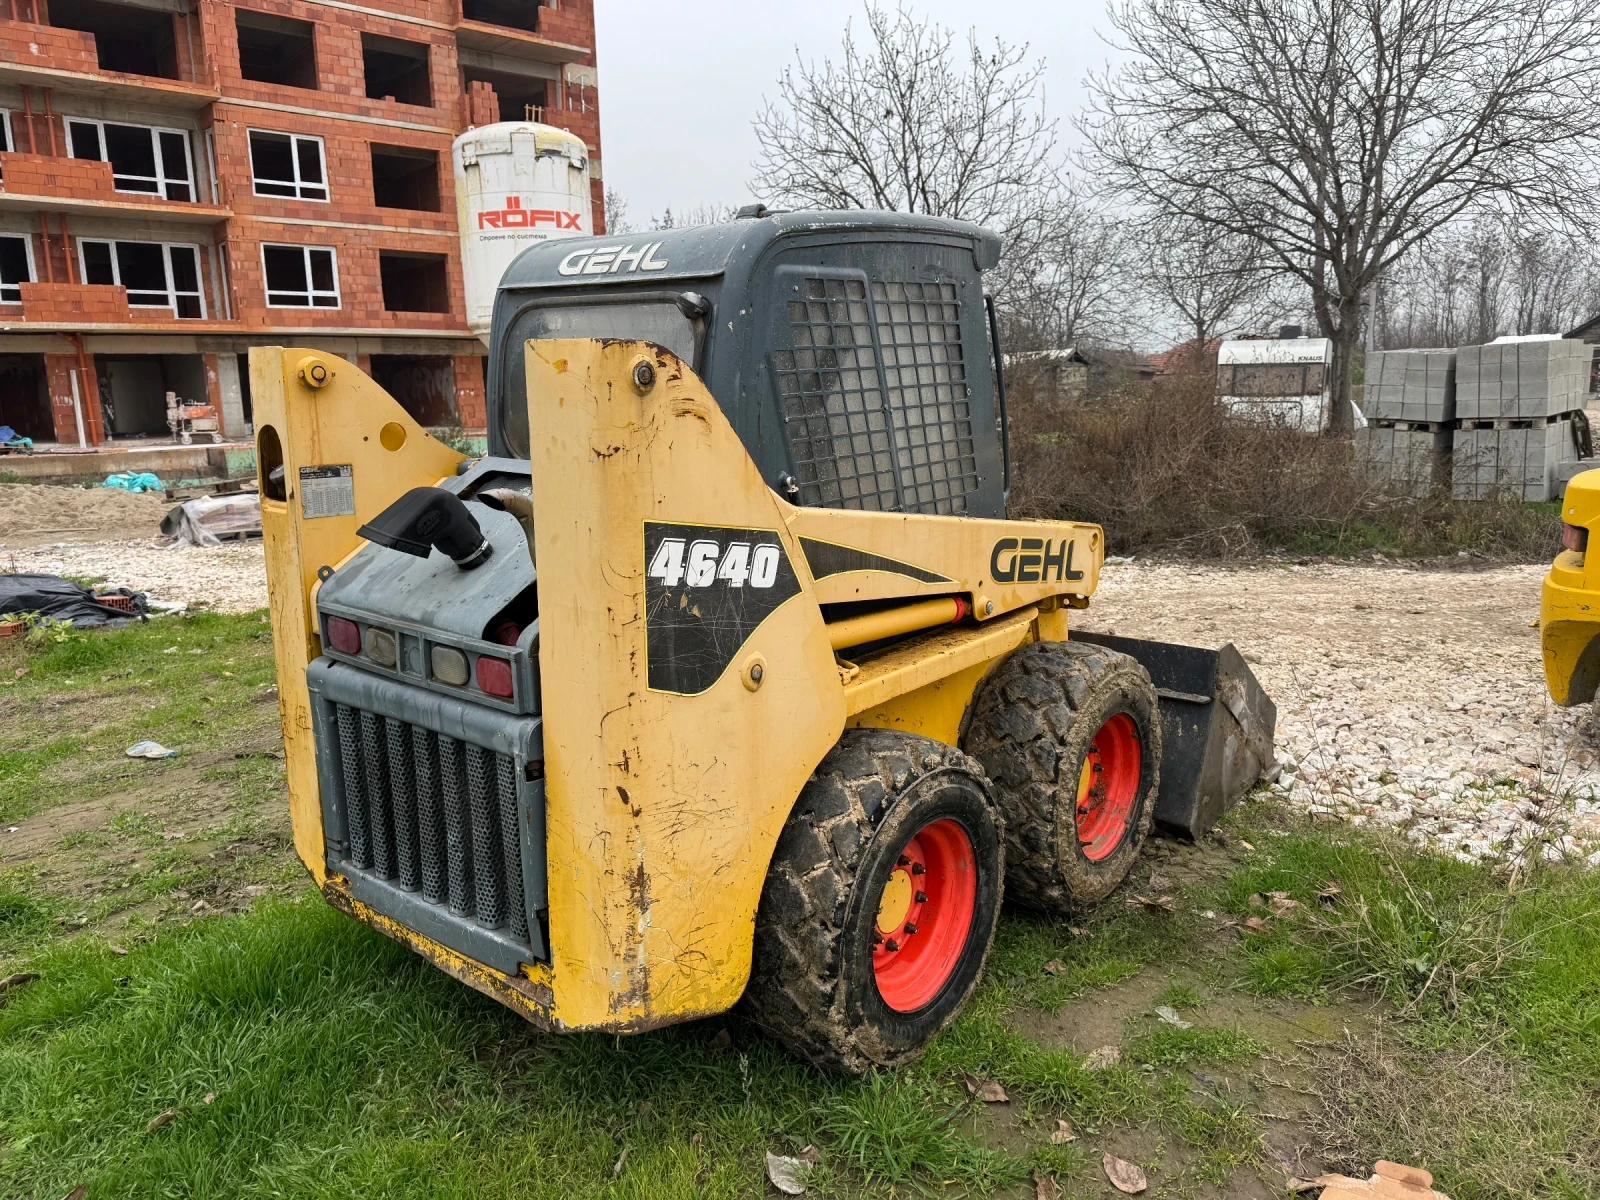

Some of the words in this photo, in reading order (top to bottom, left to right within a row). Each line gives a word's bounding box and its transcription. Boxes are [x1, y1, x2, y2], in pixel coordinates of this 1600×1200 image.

[477, 195, 582, 231] RÖFIX
[479, 234, 506, 242] Строене
[557, 241, 669, 276] GEHL
[648, 537, 780, 588] 4640
[990, 537, 1084, 583] GEHL
